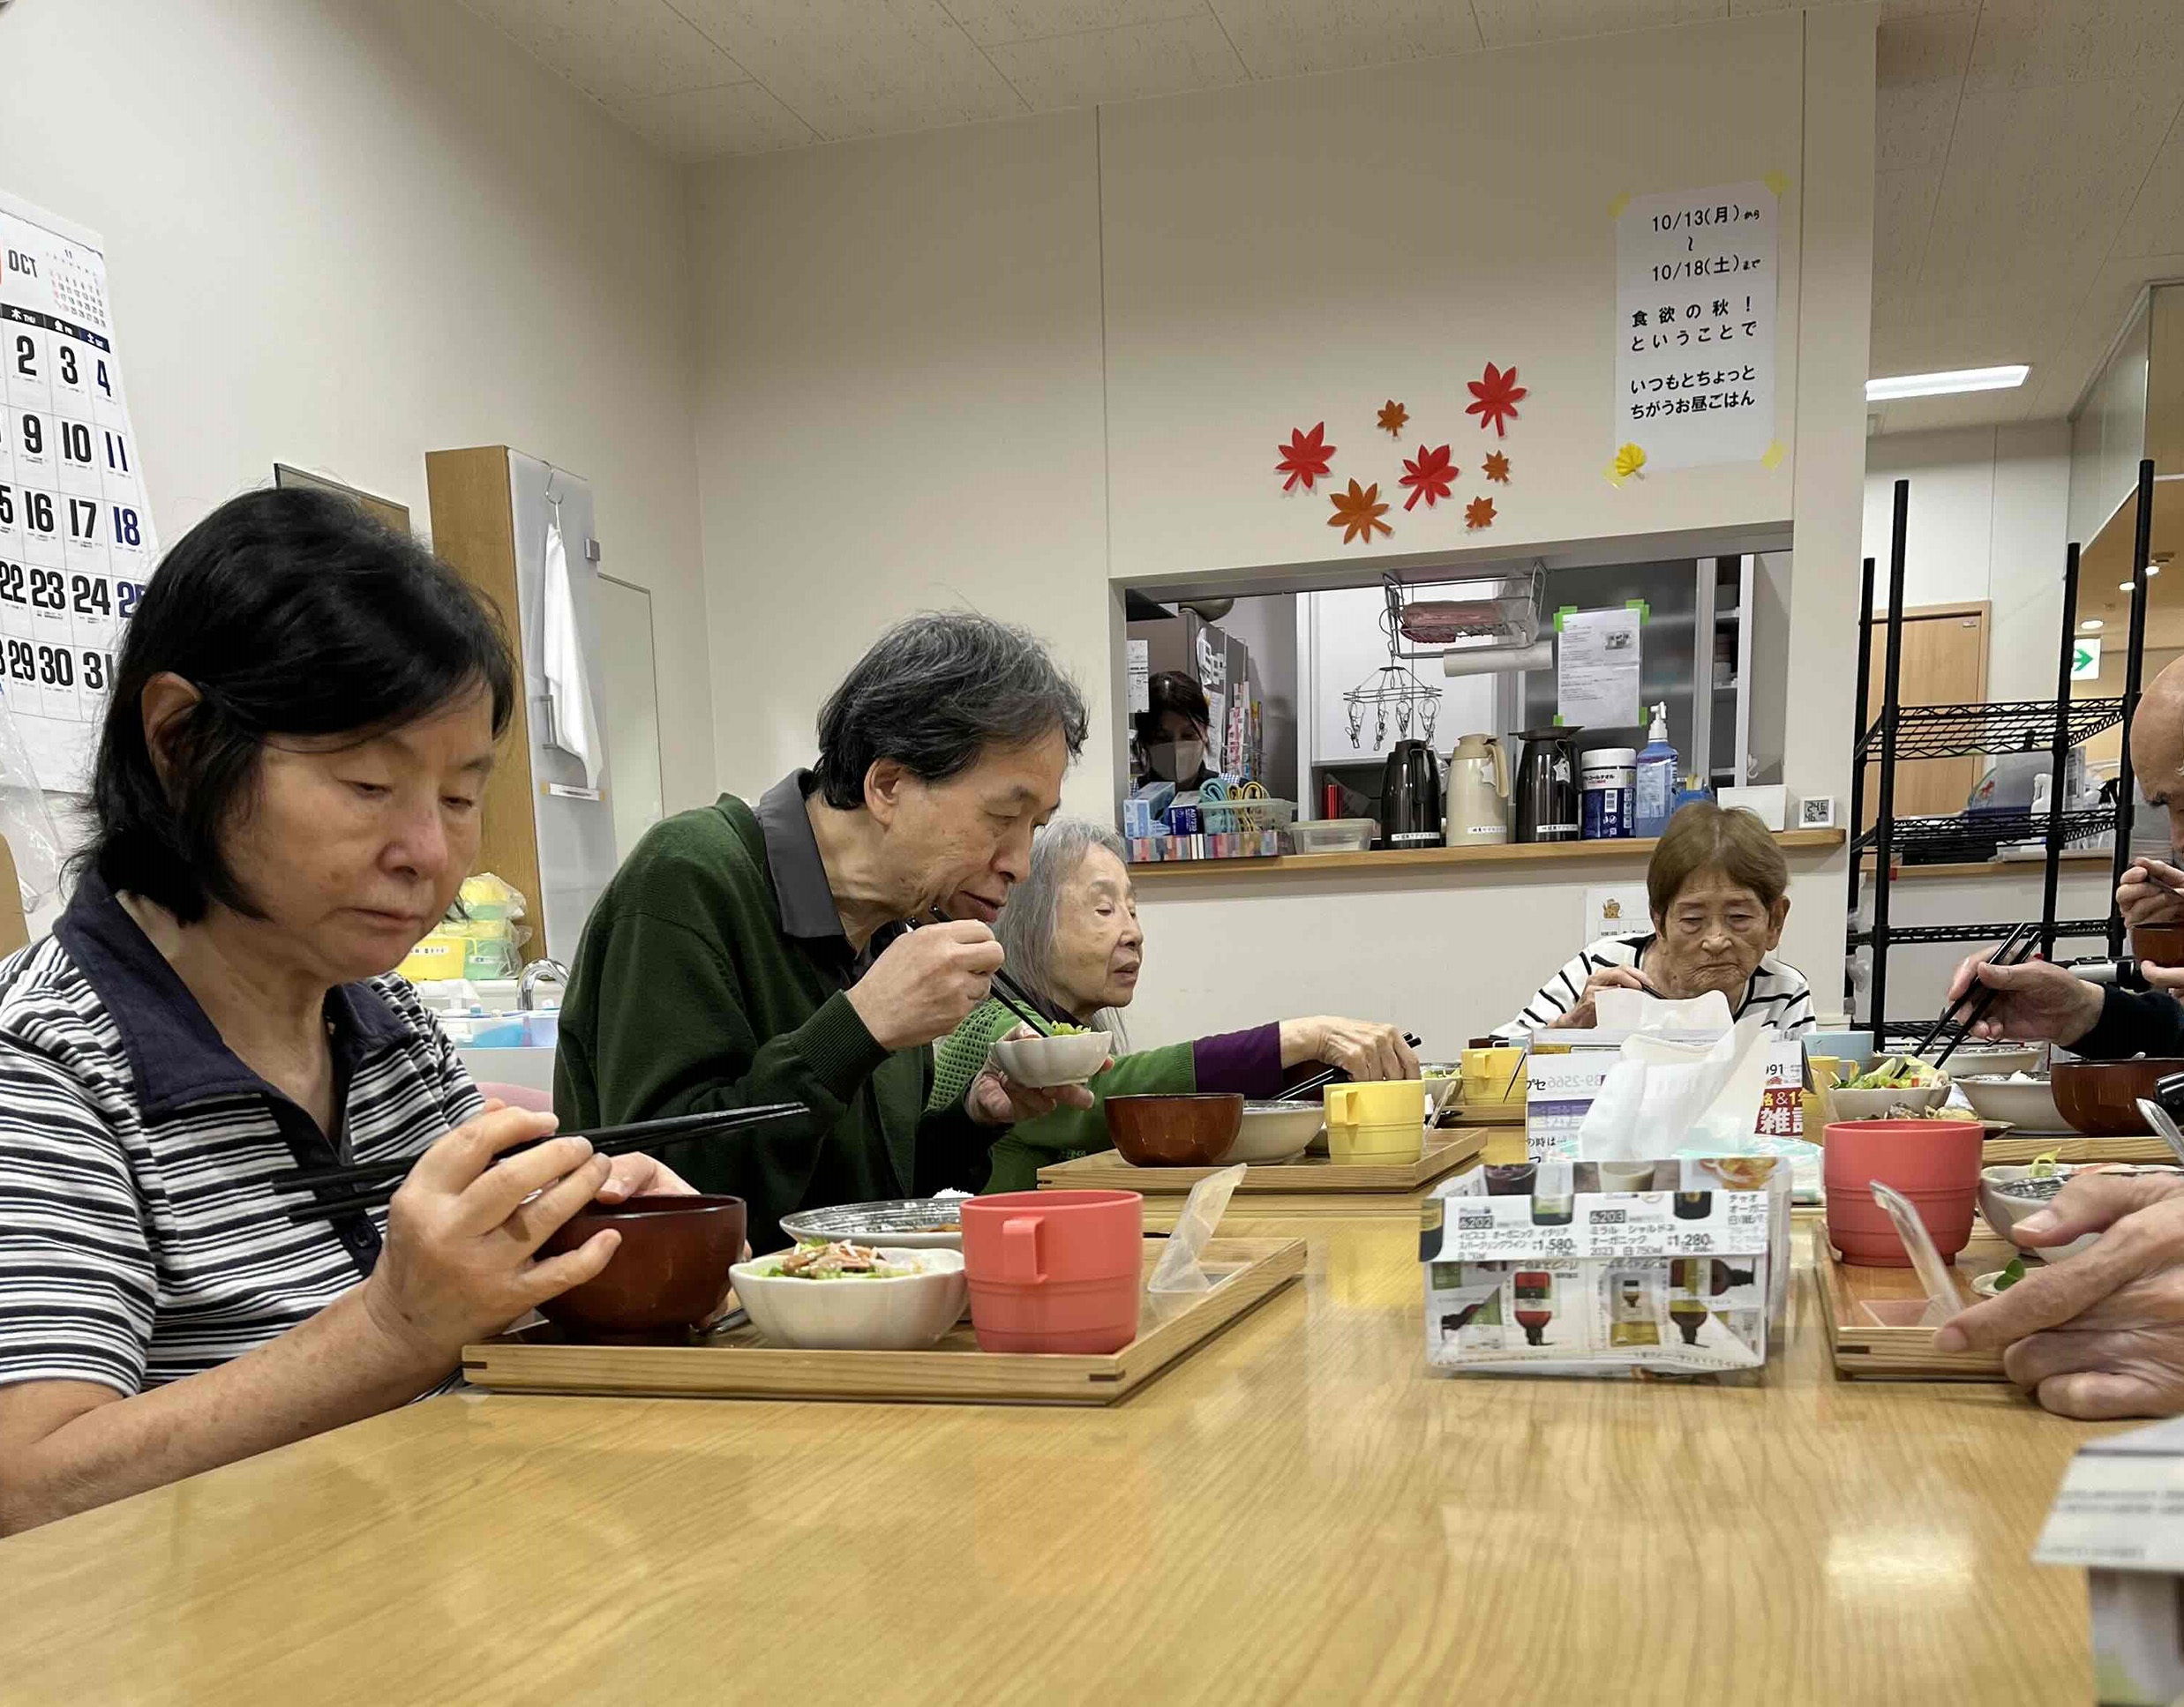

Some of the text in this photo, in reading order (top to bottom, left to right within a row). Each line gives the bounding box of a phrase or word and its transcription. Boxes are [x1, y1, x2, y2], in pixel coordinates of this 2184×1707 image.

[8, 250, 37, 278] OCT
[1632, 321, 1757, 351] ということで
[16, 335, 111, 397] 2 3 4
[1631, 365, 1755, 393] いつもとちょっと
[1631, 391, 1755, 419] ちがうお昼ごはん
[23, 415, 129, 472] 9 10 11
[25, 490, 54, 533] 16
[70, 498, 96, 538] 17
[113, 506, 140, 546] 18
[0, 561, 26, 603] 22
[30, 569, 65, 610] 23
[72, 575, 110, 615] 24
[8, 640, 35, 681] 29
[39, 646, 73, 685] 30
